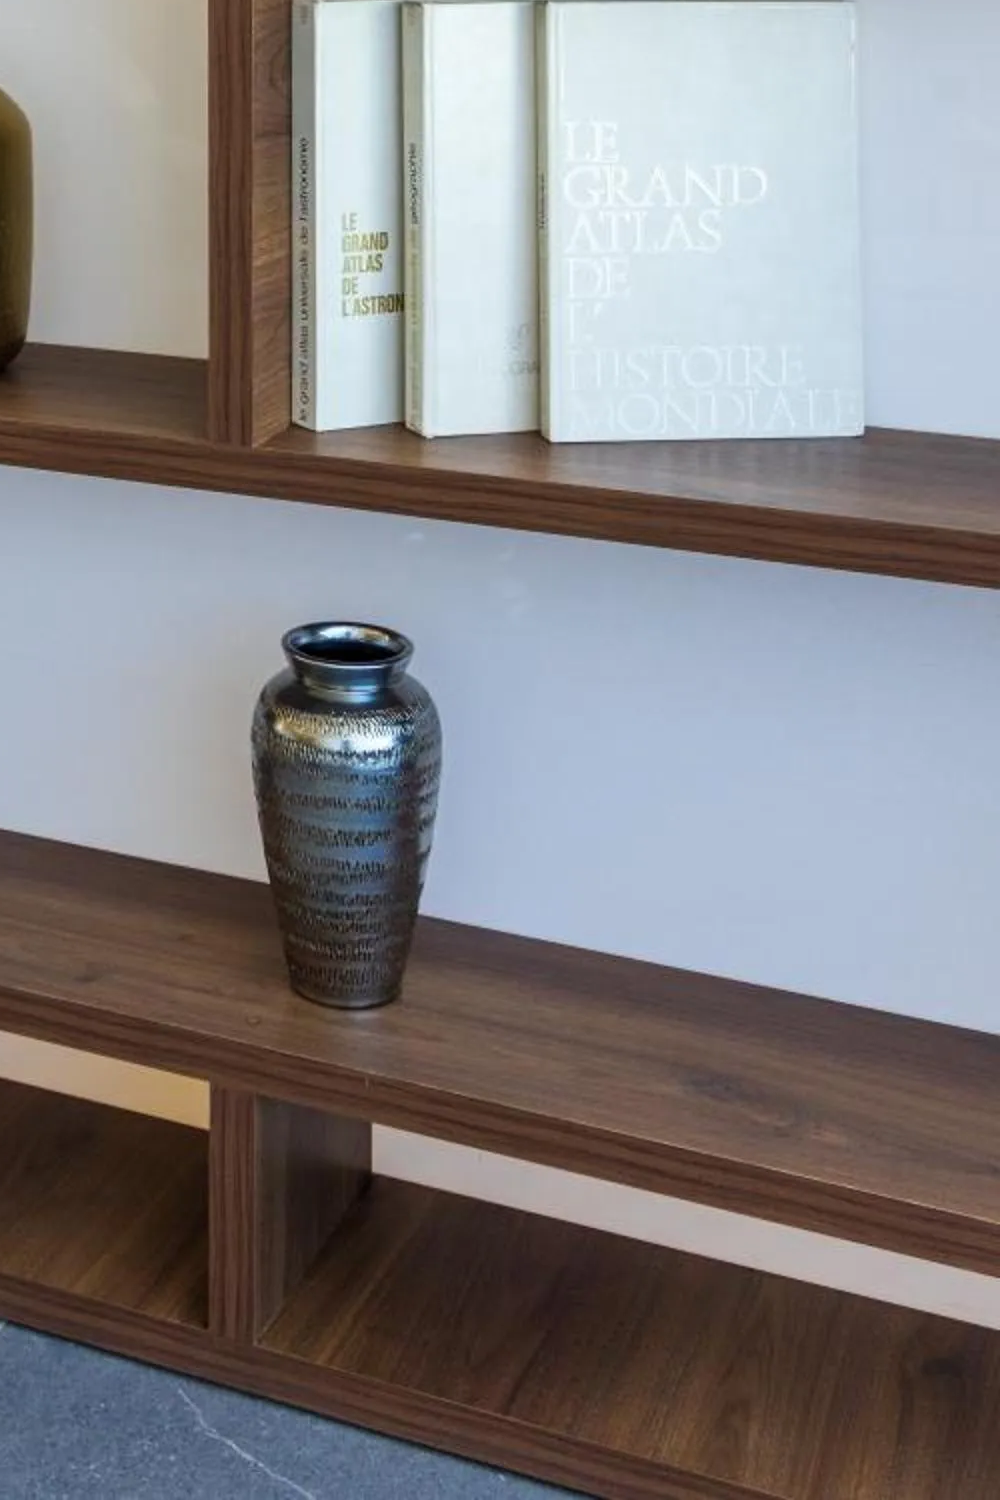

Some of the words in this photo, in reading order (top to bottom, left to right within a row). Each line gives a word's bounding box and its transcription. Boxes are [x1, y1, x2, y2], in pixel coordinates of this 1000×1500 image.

[562, 120, 620, 162] LE
[562, 162, 769, 209] GRAND
[341, 212, 357, 231] LE
[341, 231, 389, 252] GRAND
[562, 209, 724, 255] ATLAS
[342, 253, 383, 273] ATLAS
[565, 257, 631, 300] DE
[341, 276, 358, 295] DE
[567, 345, 807, 391] HISTOIRE
[568, 389, 860, 435] MONDIALE
